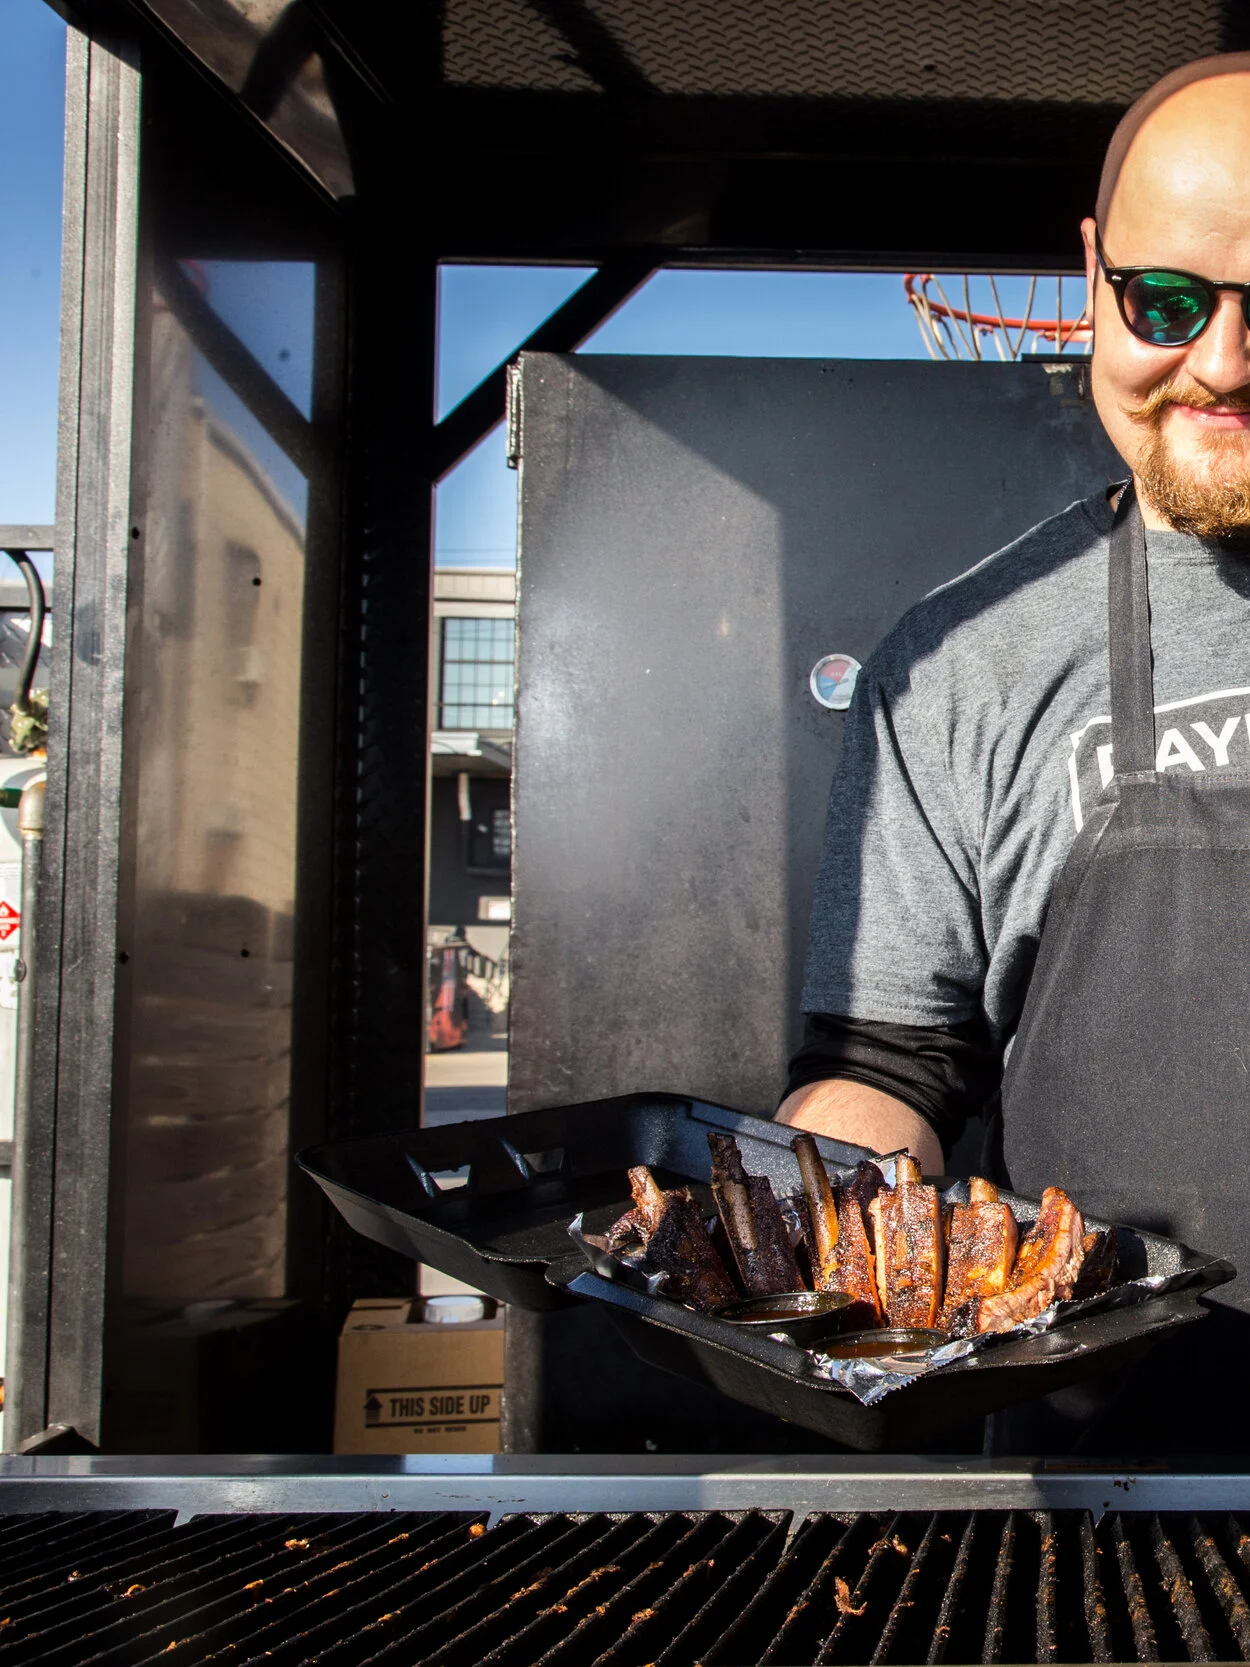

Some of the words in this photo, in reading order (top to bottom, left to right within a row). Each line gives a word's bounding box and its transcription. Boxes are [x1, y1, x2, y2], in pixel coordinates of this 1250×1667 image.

[389, 1398, 425, 1418] THIS
[429, 1396, 465, 1415] SIDE
[469, 1395, 490, 1414] UP
